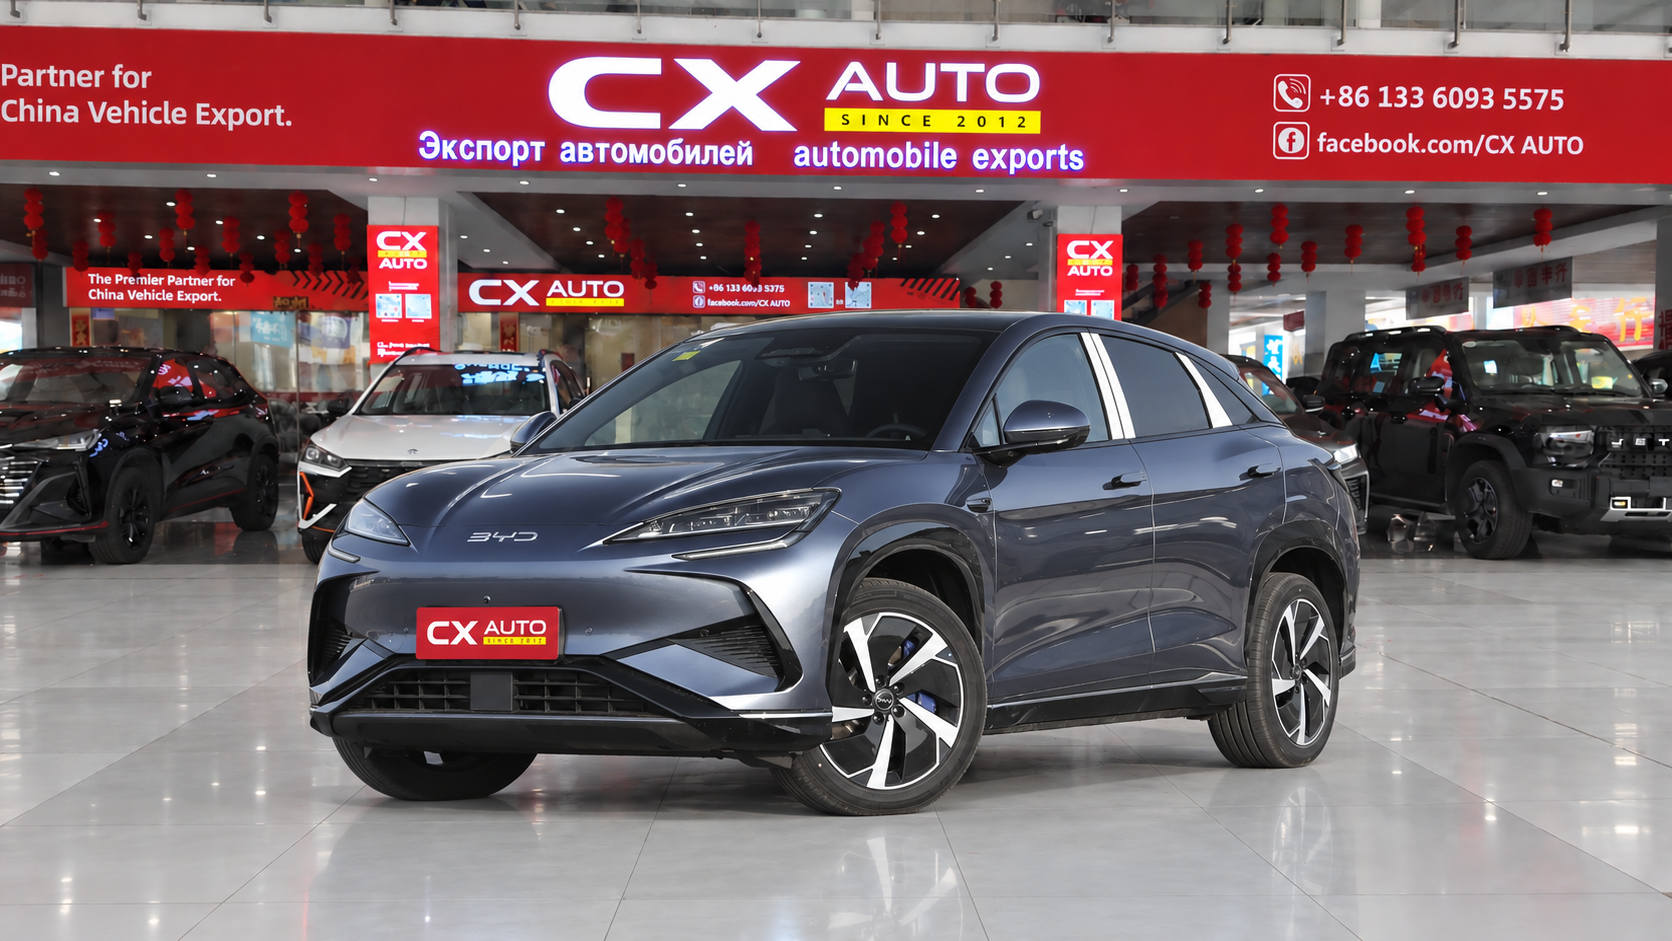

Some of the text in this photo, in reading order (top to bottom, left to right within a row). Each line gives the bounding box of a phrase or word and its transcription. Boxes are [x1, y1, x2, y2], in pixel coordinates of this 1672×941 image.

[1, 63, 152, 89] Partner for
[548, 56, 1041, 132] CX AUTO
[1320, 85, 1564, 110] +86 133 6093 5575
[1, 98, 293, 132] China Vehicle Export.
[841, 113, 1026, 129] SINCE 2012
[418, 130, 753, 166] Экспорт автомобилей
[1317, 132, 1585, 156] facebook.com/CX AUTO
[793, 140, 1085, 175] automobile exports
[376, 230, 427, 251] CX
[1066, 240, 1114, 260] CX
[378, 258, 428, 270] AUTO
[1067, 266, 1113, 276] AUTO
[88, 273, 236, 287] The Premier Partner for
[726, 284, 740, 292] 133
[88, 288, 222, 304] China Vehicle Export.
[468, 279, 625, 306] CX AUTO
[466, 531, 539, 543] BYD
[426, 619, 547, 646] CX AUTO
